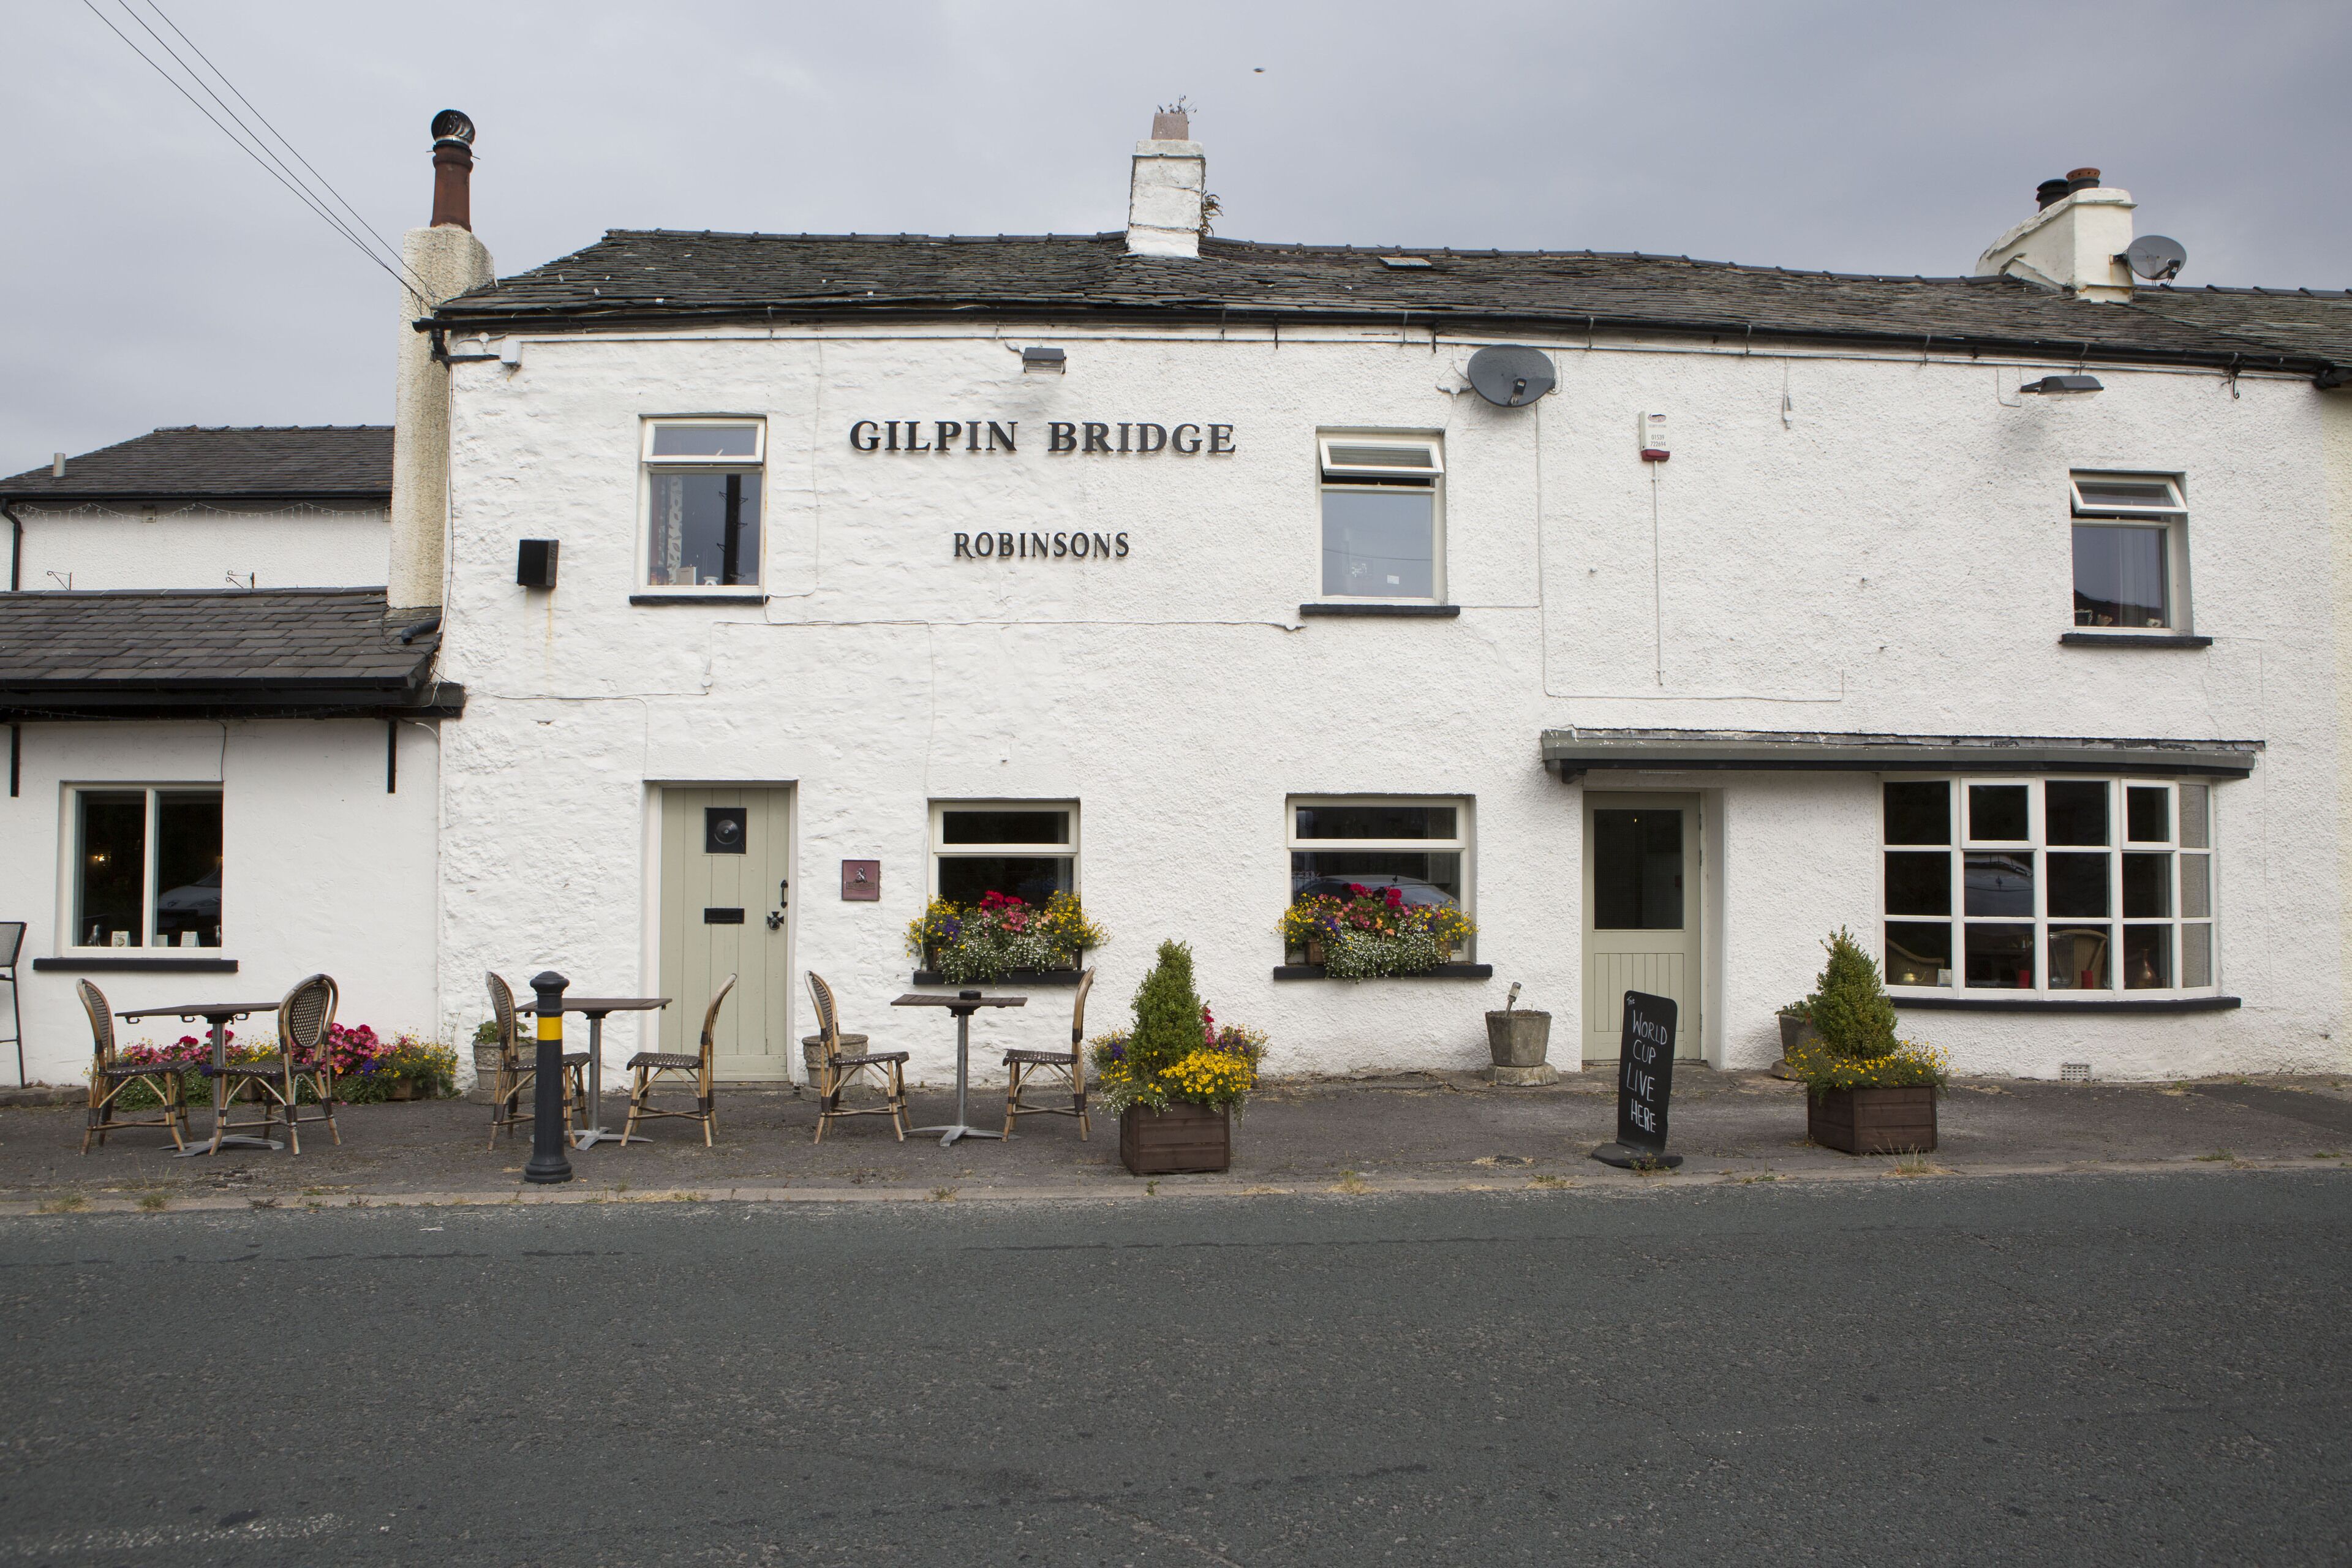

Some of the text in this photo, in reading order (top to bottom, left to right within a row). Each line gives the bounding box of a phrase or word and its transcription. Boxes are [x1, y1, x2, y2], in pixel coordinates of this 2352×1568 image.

[850, 420, 1237, 454] GILPIN BRIDGE
[954, 532, 1130, 560] ROBINSONS
[1633, 1009, 1667, 1045] WORLD
[1633, 1039, 1656, 1065] CUP
[1627, 1062, 1655, 1102] LIVE
[1631, 1098, 1656, 1133] HERE
